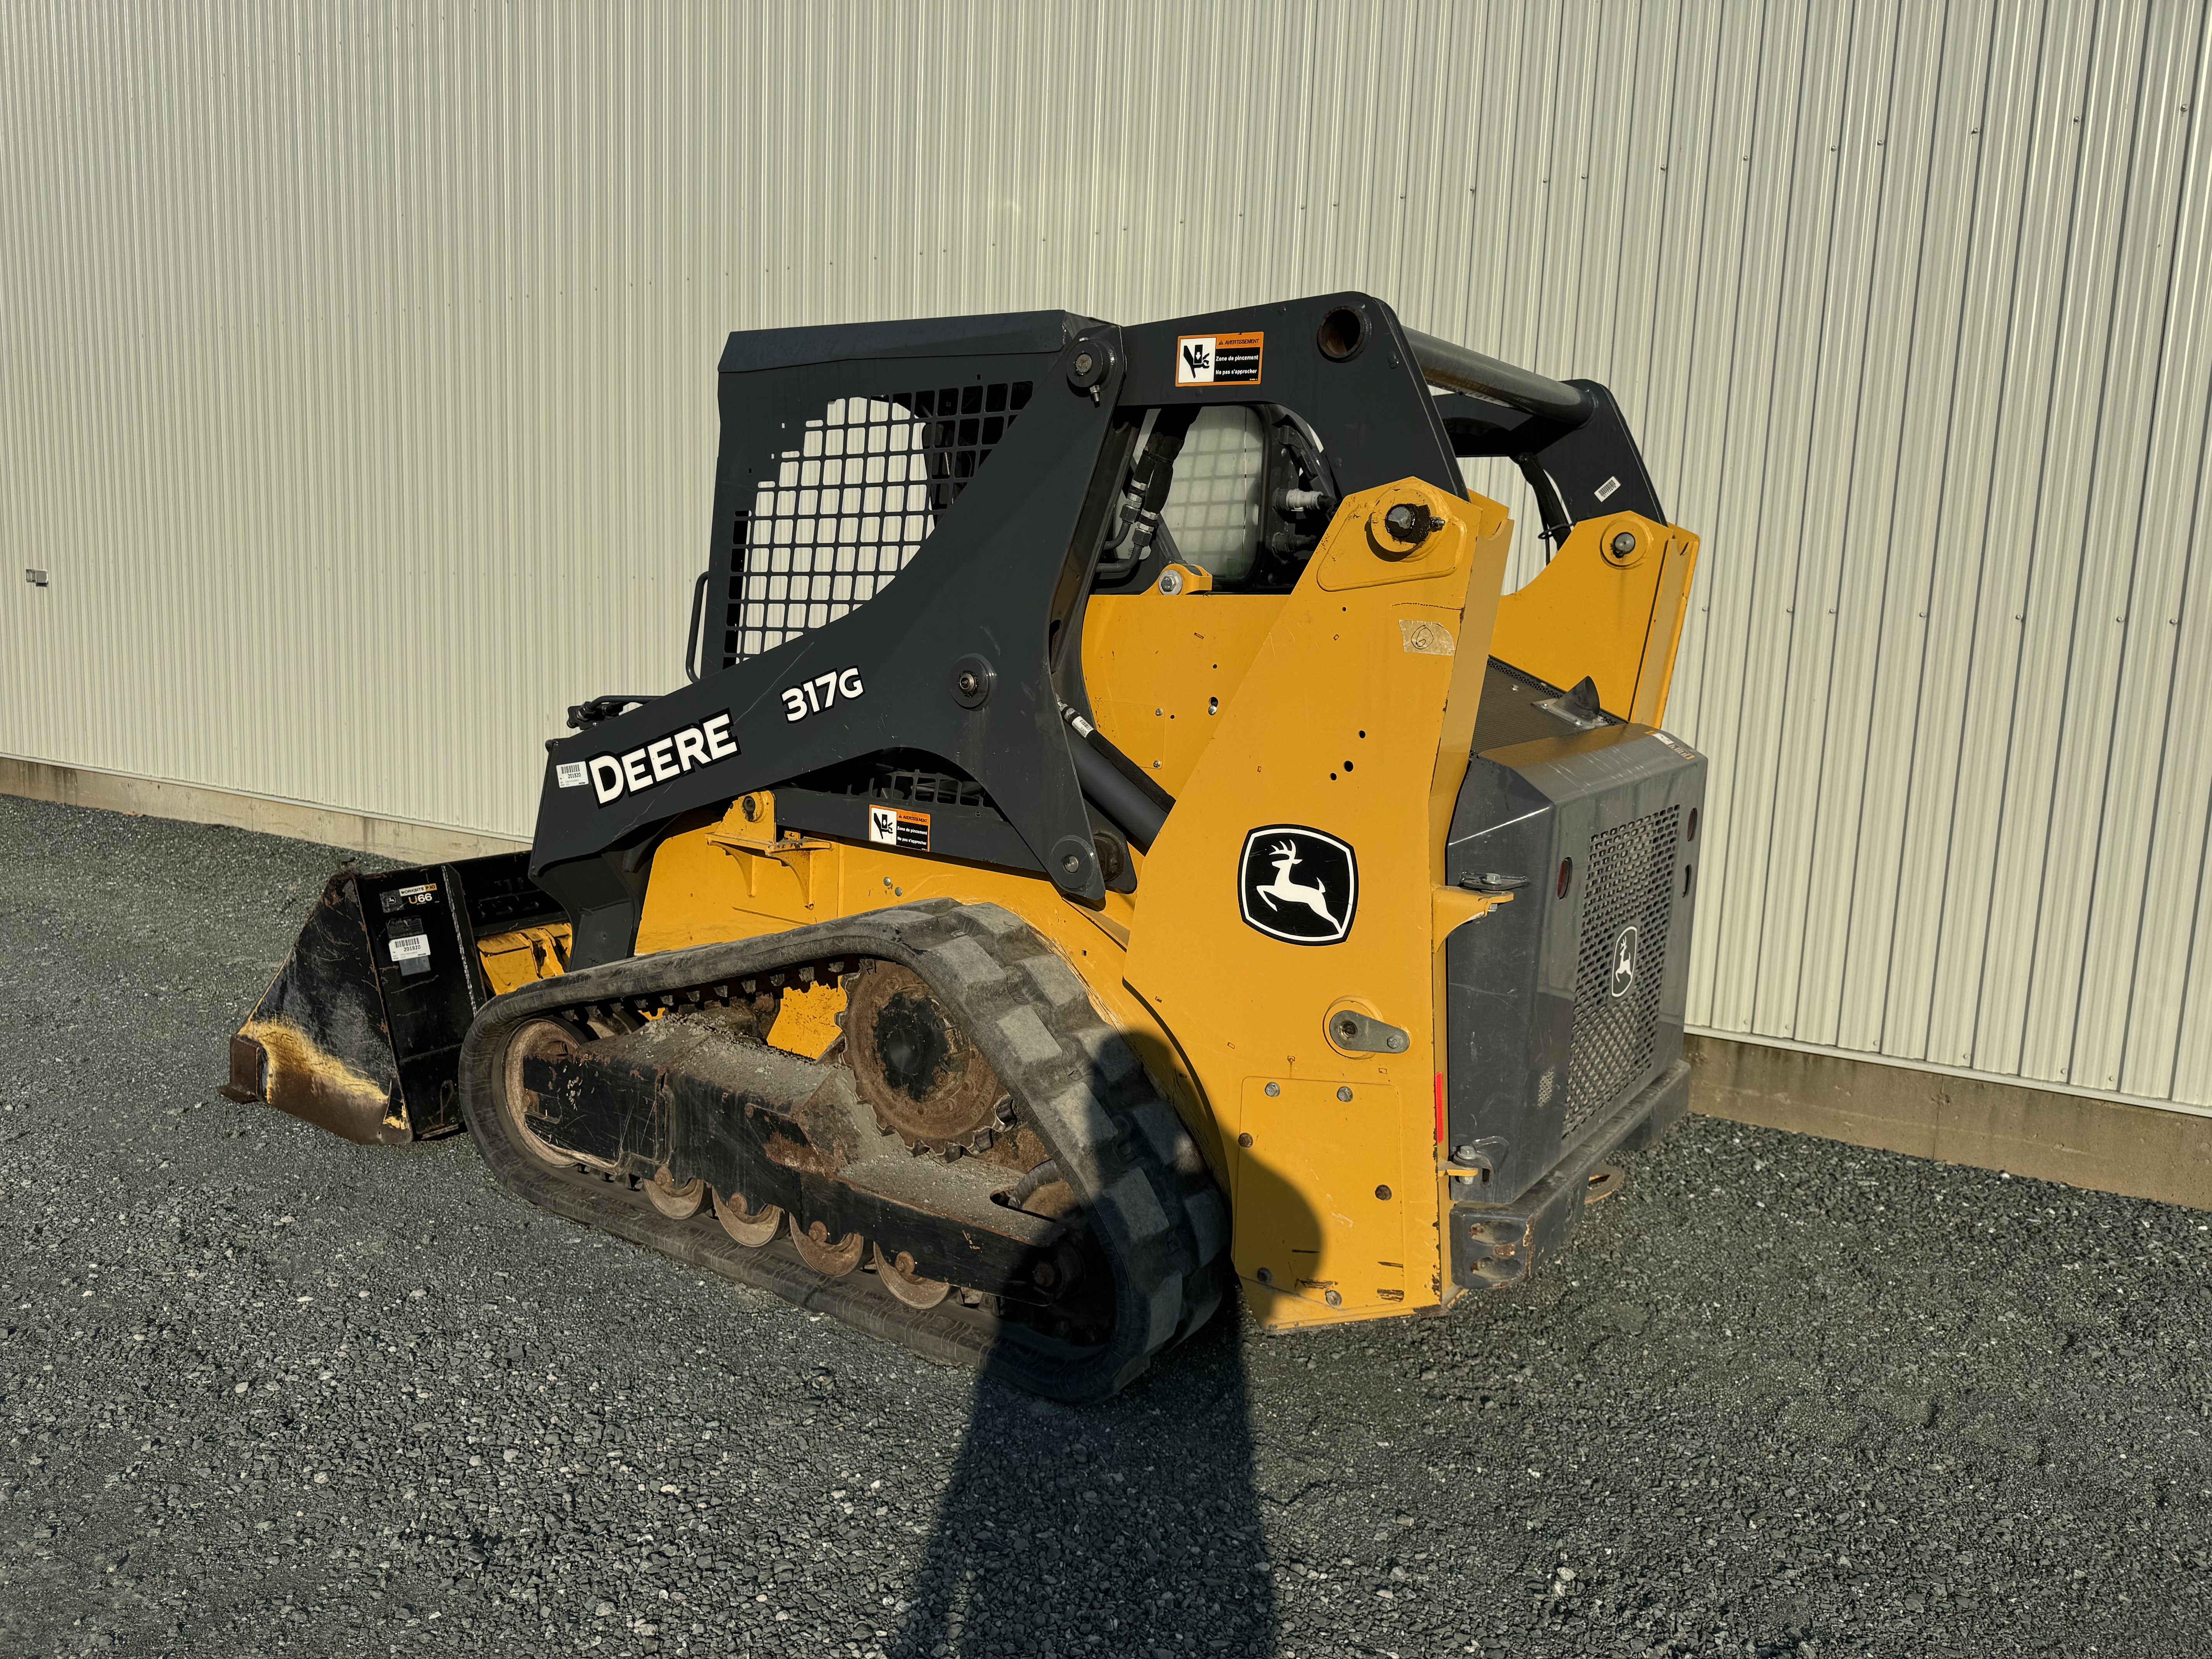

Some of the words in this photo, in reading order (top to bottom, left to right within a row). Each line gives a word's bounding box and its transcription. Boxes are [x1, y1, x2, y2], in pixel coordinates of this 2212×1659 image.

[781, 668, 864, 721] 317G
[589, 714, 738, 804] DEERE
[408, 893, 432, 904] U66
